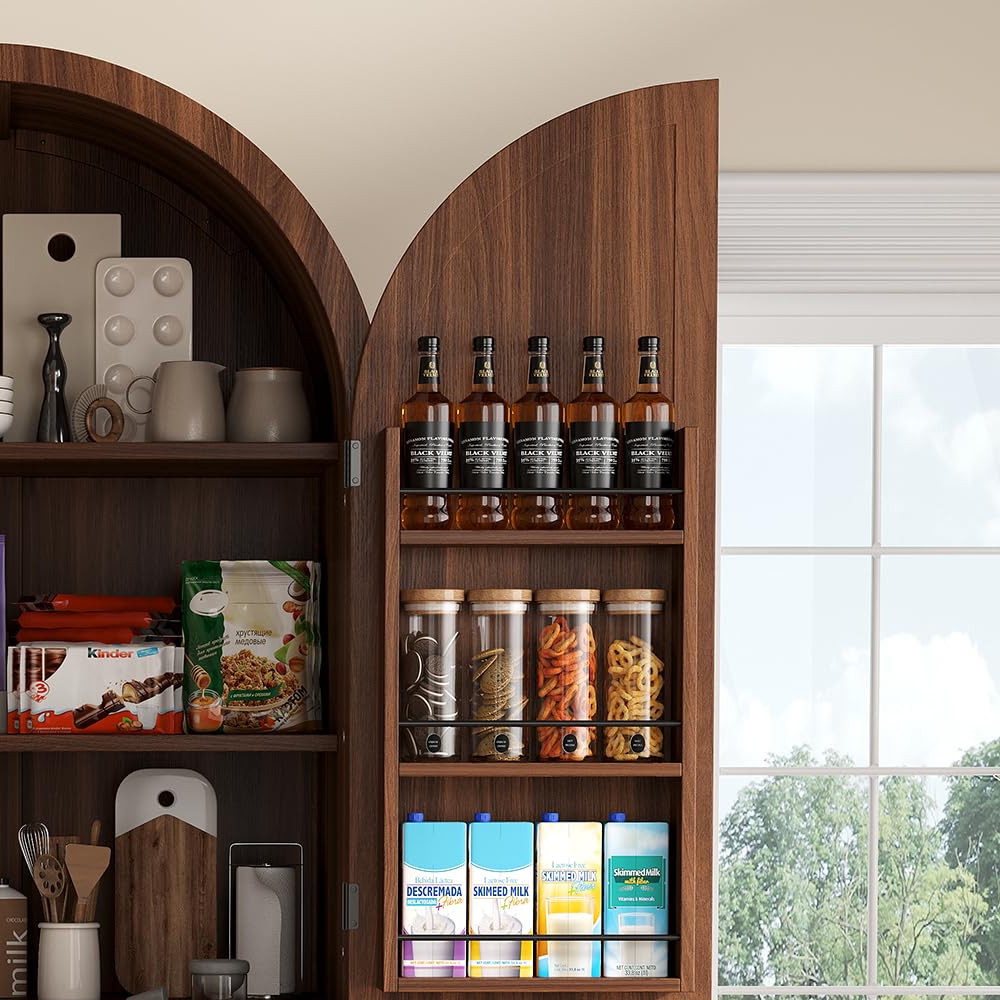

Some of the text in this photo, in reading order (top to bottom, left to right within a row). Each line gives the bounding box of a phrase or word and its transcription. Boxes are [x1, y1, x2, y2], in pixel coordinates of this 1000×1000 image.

[542, 871, 597, 881] SKIMMED MILK
[614, 868, 660, 876] Skimmed Milk
[407, 886, 462, 896] DESCREMADA
[473, 886, 529, 896] SKIMEED MILK
[6, 930, 27, 996] milk
